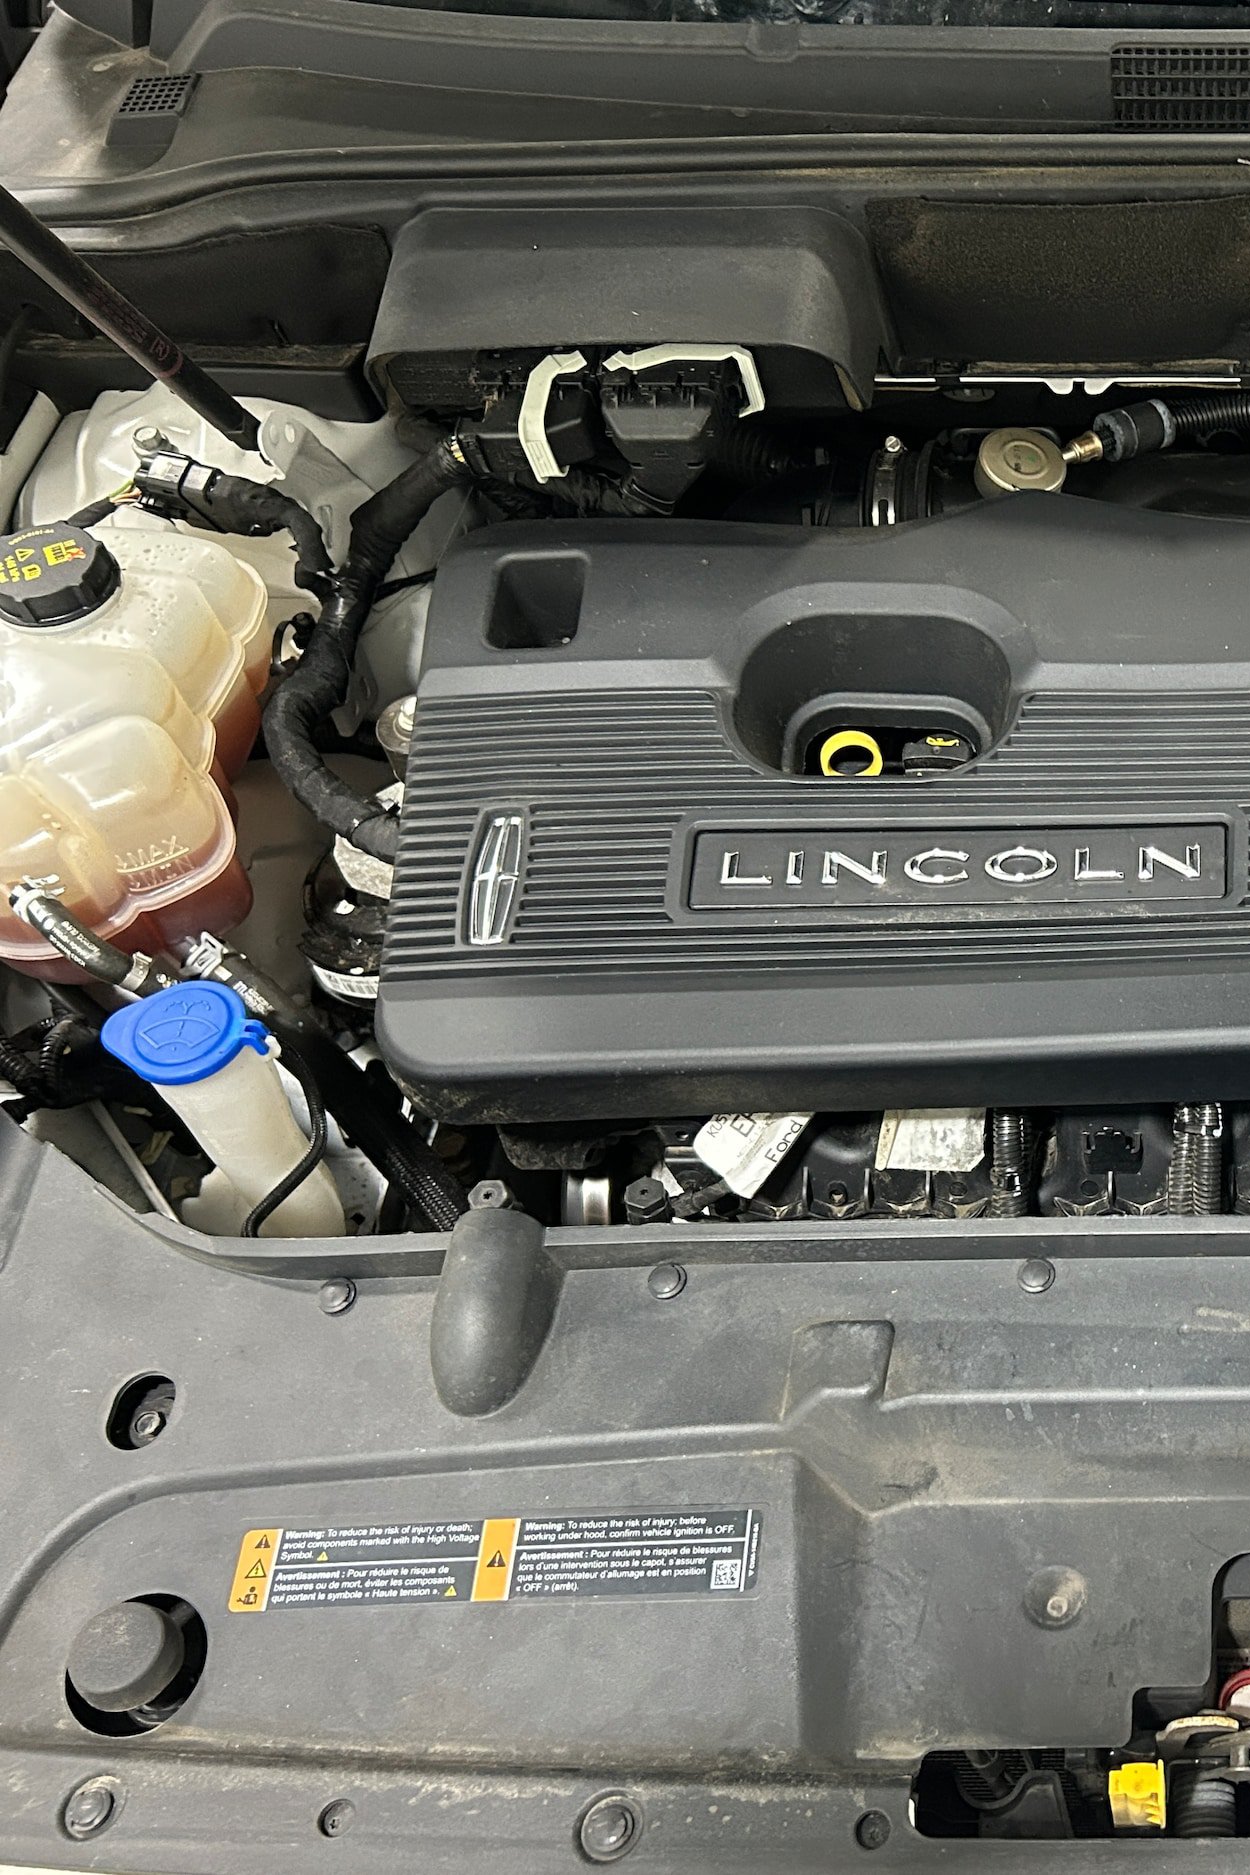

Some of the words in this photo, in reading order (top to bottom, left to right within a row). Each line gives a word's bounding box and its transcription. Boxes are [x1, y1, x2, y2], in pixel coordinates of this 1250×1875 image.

[720, 843, 1200, 885] LINCOLN
[764, 1118, 804, 1163] Ford
[286, 1530, 326, 1540] Warning:
[328, 1528, 338, 1537] To
[339, 1528, 368, 1536] reduce
[370, 1526, 383, 1536] the
[384, 1526, 399, 1535] risk
[401, 1524, 411, 1534] of
[412, 1524, 434, 1536] injury
[436, 1525, 446, 1533] or
[525, 1522, 565, 1532] Warning:
[568, 1521, 578, 1529] To
[580, 1520, 608, 1529] reduce
[610, 1520, 623, 1528] the
[625, 1518, 640, 1528] risk
[642, 1518, 651, 1526] of
[680, 1516, 707, 1525] before
[282, 1540, 306, 1550] avoid
[307, 1538, 358, 1550] components
[360, 1536, 392, 1546] marked
[393, 1536, 410, 1544] with
[412, 1535, 425, 1544] the
[427, 1534, 446, 1545] High
[448, 1534, 480, 1544] Voltage
[524, 1532, 556, 1542] working
[558, 1530, 582, 1540] under
[609, 1528, 640, 1538] confirm
[642, 1528, 672, 1537] vehicle
[674, 1526, 704, 1538] ignition
[706, 1526, 713, 1534] is
[520, 1550, 584, 1561] Avertissement
[590, 1550, 611, 1558] Pour
[643, 1548, 650, 1556] le
[652, 1547, 678, 1558] risque
[680, 1546, 690, 1555] de
[692, 1546, 732, 1554] blessures
[518, 1562, 534, 1572] lors
[560, 1560, 608, 1570] intervention
[610, 1560, 630, 1568] sous
[632, 1558, 640, 1567] le
[275, 1570, 340, 1582] Avertissement
[346, 1568, 368, 1578] Pour
[400, 1567, 409, 1576] le
[410, 1566, 436, 1576] risque
[438, 1565, 450, 1574] de
[516, 1574, 534, 1583] que
[544, 1571, 598, 1581] commutateur
[646, 1568, 660, 1578] est
[674, 1568, 706, 1578] position
[273, 1582, 314, 1592] blessures
[316, 1582, 327, 1590] ou
[328, 1581, 340, 1590] de
[390, 1578, 402, 1586] les
[404, 1576, 456, 1586] composants
[523, 1583, 542, 1592] OFF
[271, 1593, 284, 1604] qui
[286, 1592, 316, 1604] portent
[318, 1591, 326, 1600] le
[327, 1590, 363, 1602] symbole
[372, 1589, 398, 1598] Haute
[400, 1588, 430, 1597] tension
